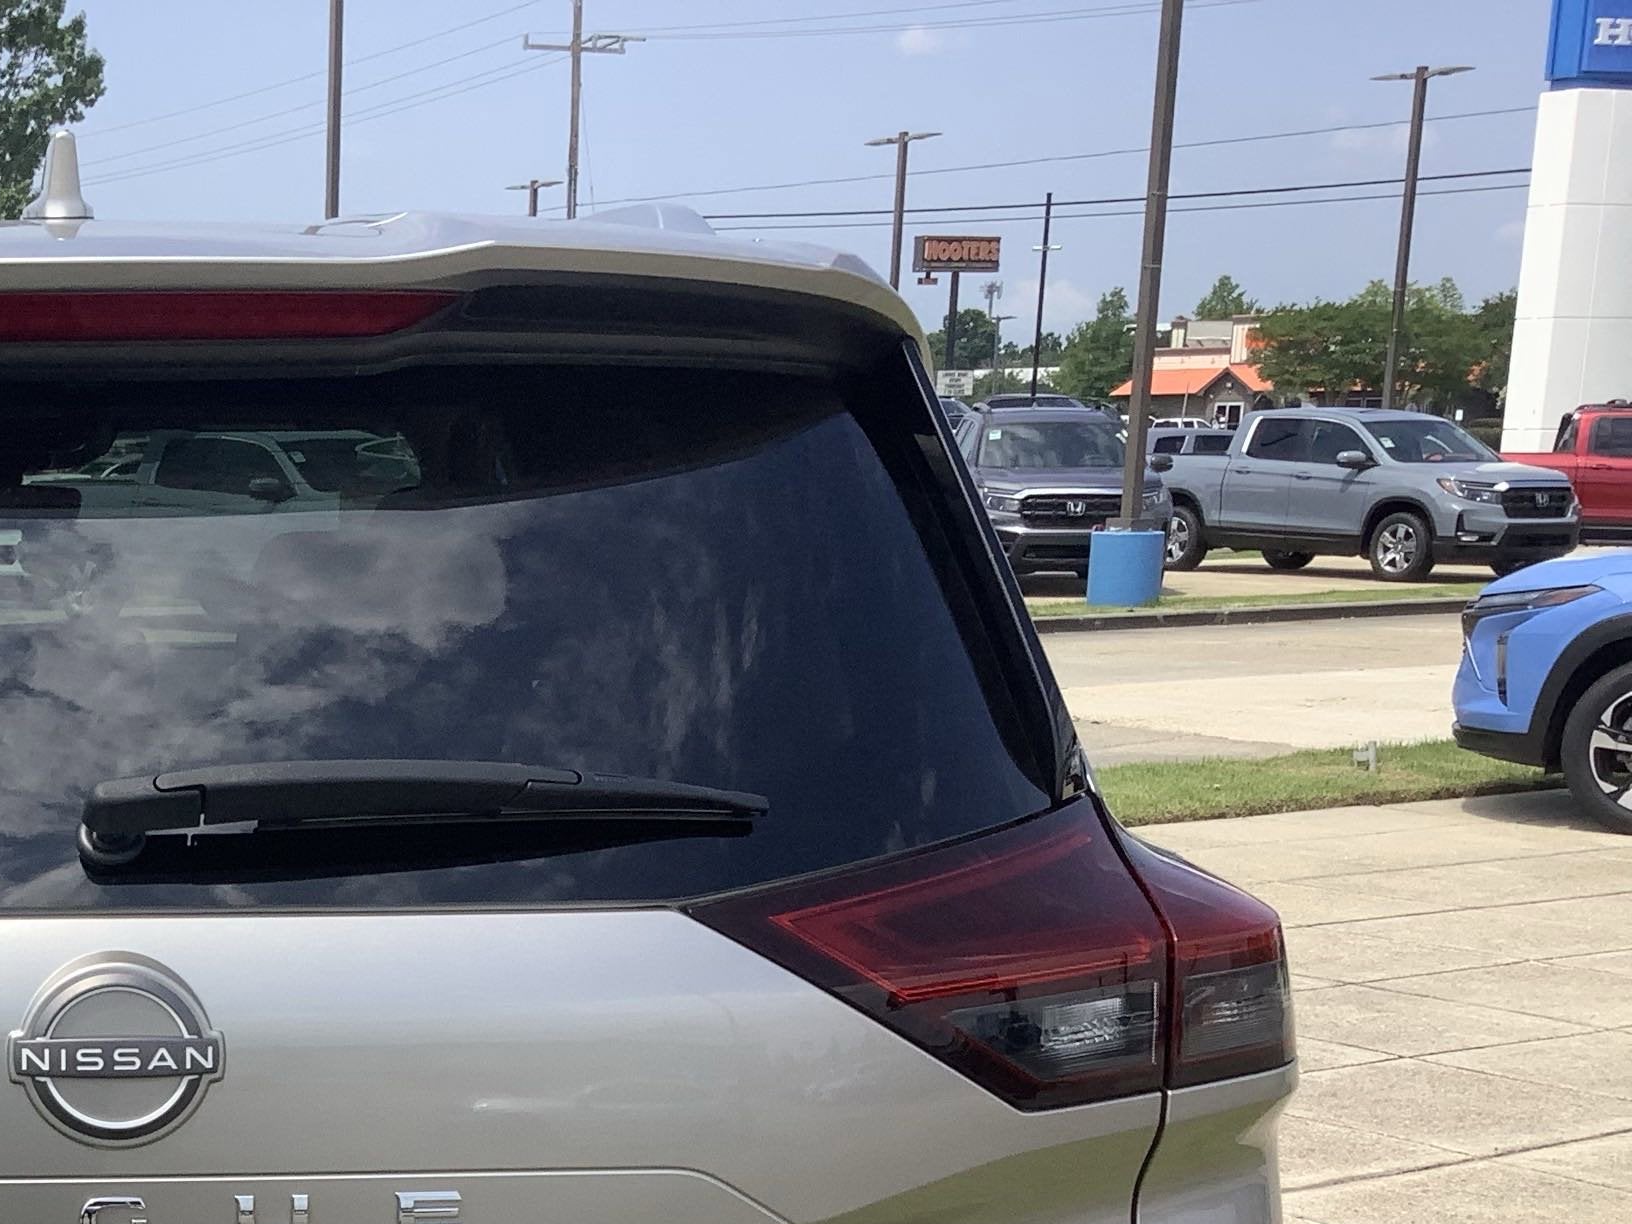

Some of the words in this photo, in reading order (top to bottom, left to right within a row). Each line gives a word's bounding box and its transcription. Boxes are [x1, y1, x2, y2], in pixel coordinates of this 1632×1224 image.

[1593, 17, 1632, 46] H
[924, 239, 999, 262] HOOTERS
[19, 1044, 216, 1073] NISSAN
